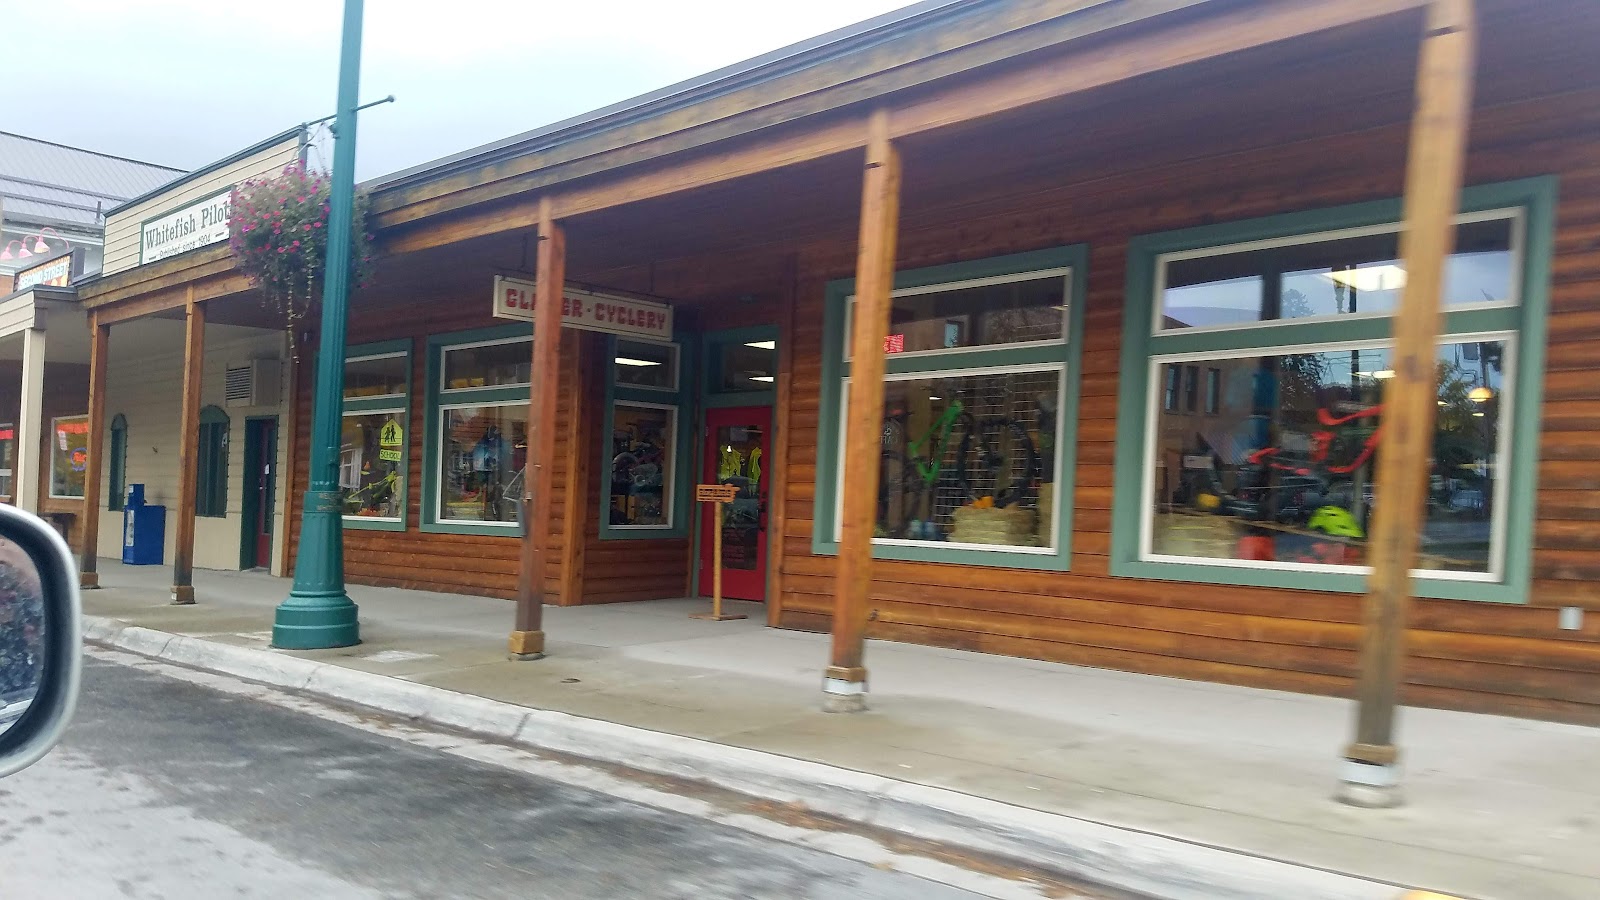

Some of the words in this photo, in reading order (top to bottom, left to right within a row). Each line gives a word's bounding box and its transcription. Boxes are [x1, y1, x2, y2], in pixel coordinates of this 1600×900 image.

[146, 213, 196, 249] Whitefish
[201, 200, 231, 229] Pilot
[198, 233, 210, 246] 1904
[43, 262, 66, 282] STREET
[505, 288, 583, 318] GLER
[595, 302, 666, 330] CYCLERY
[380, 450, 400, 460] SCHOOL
